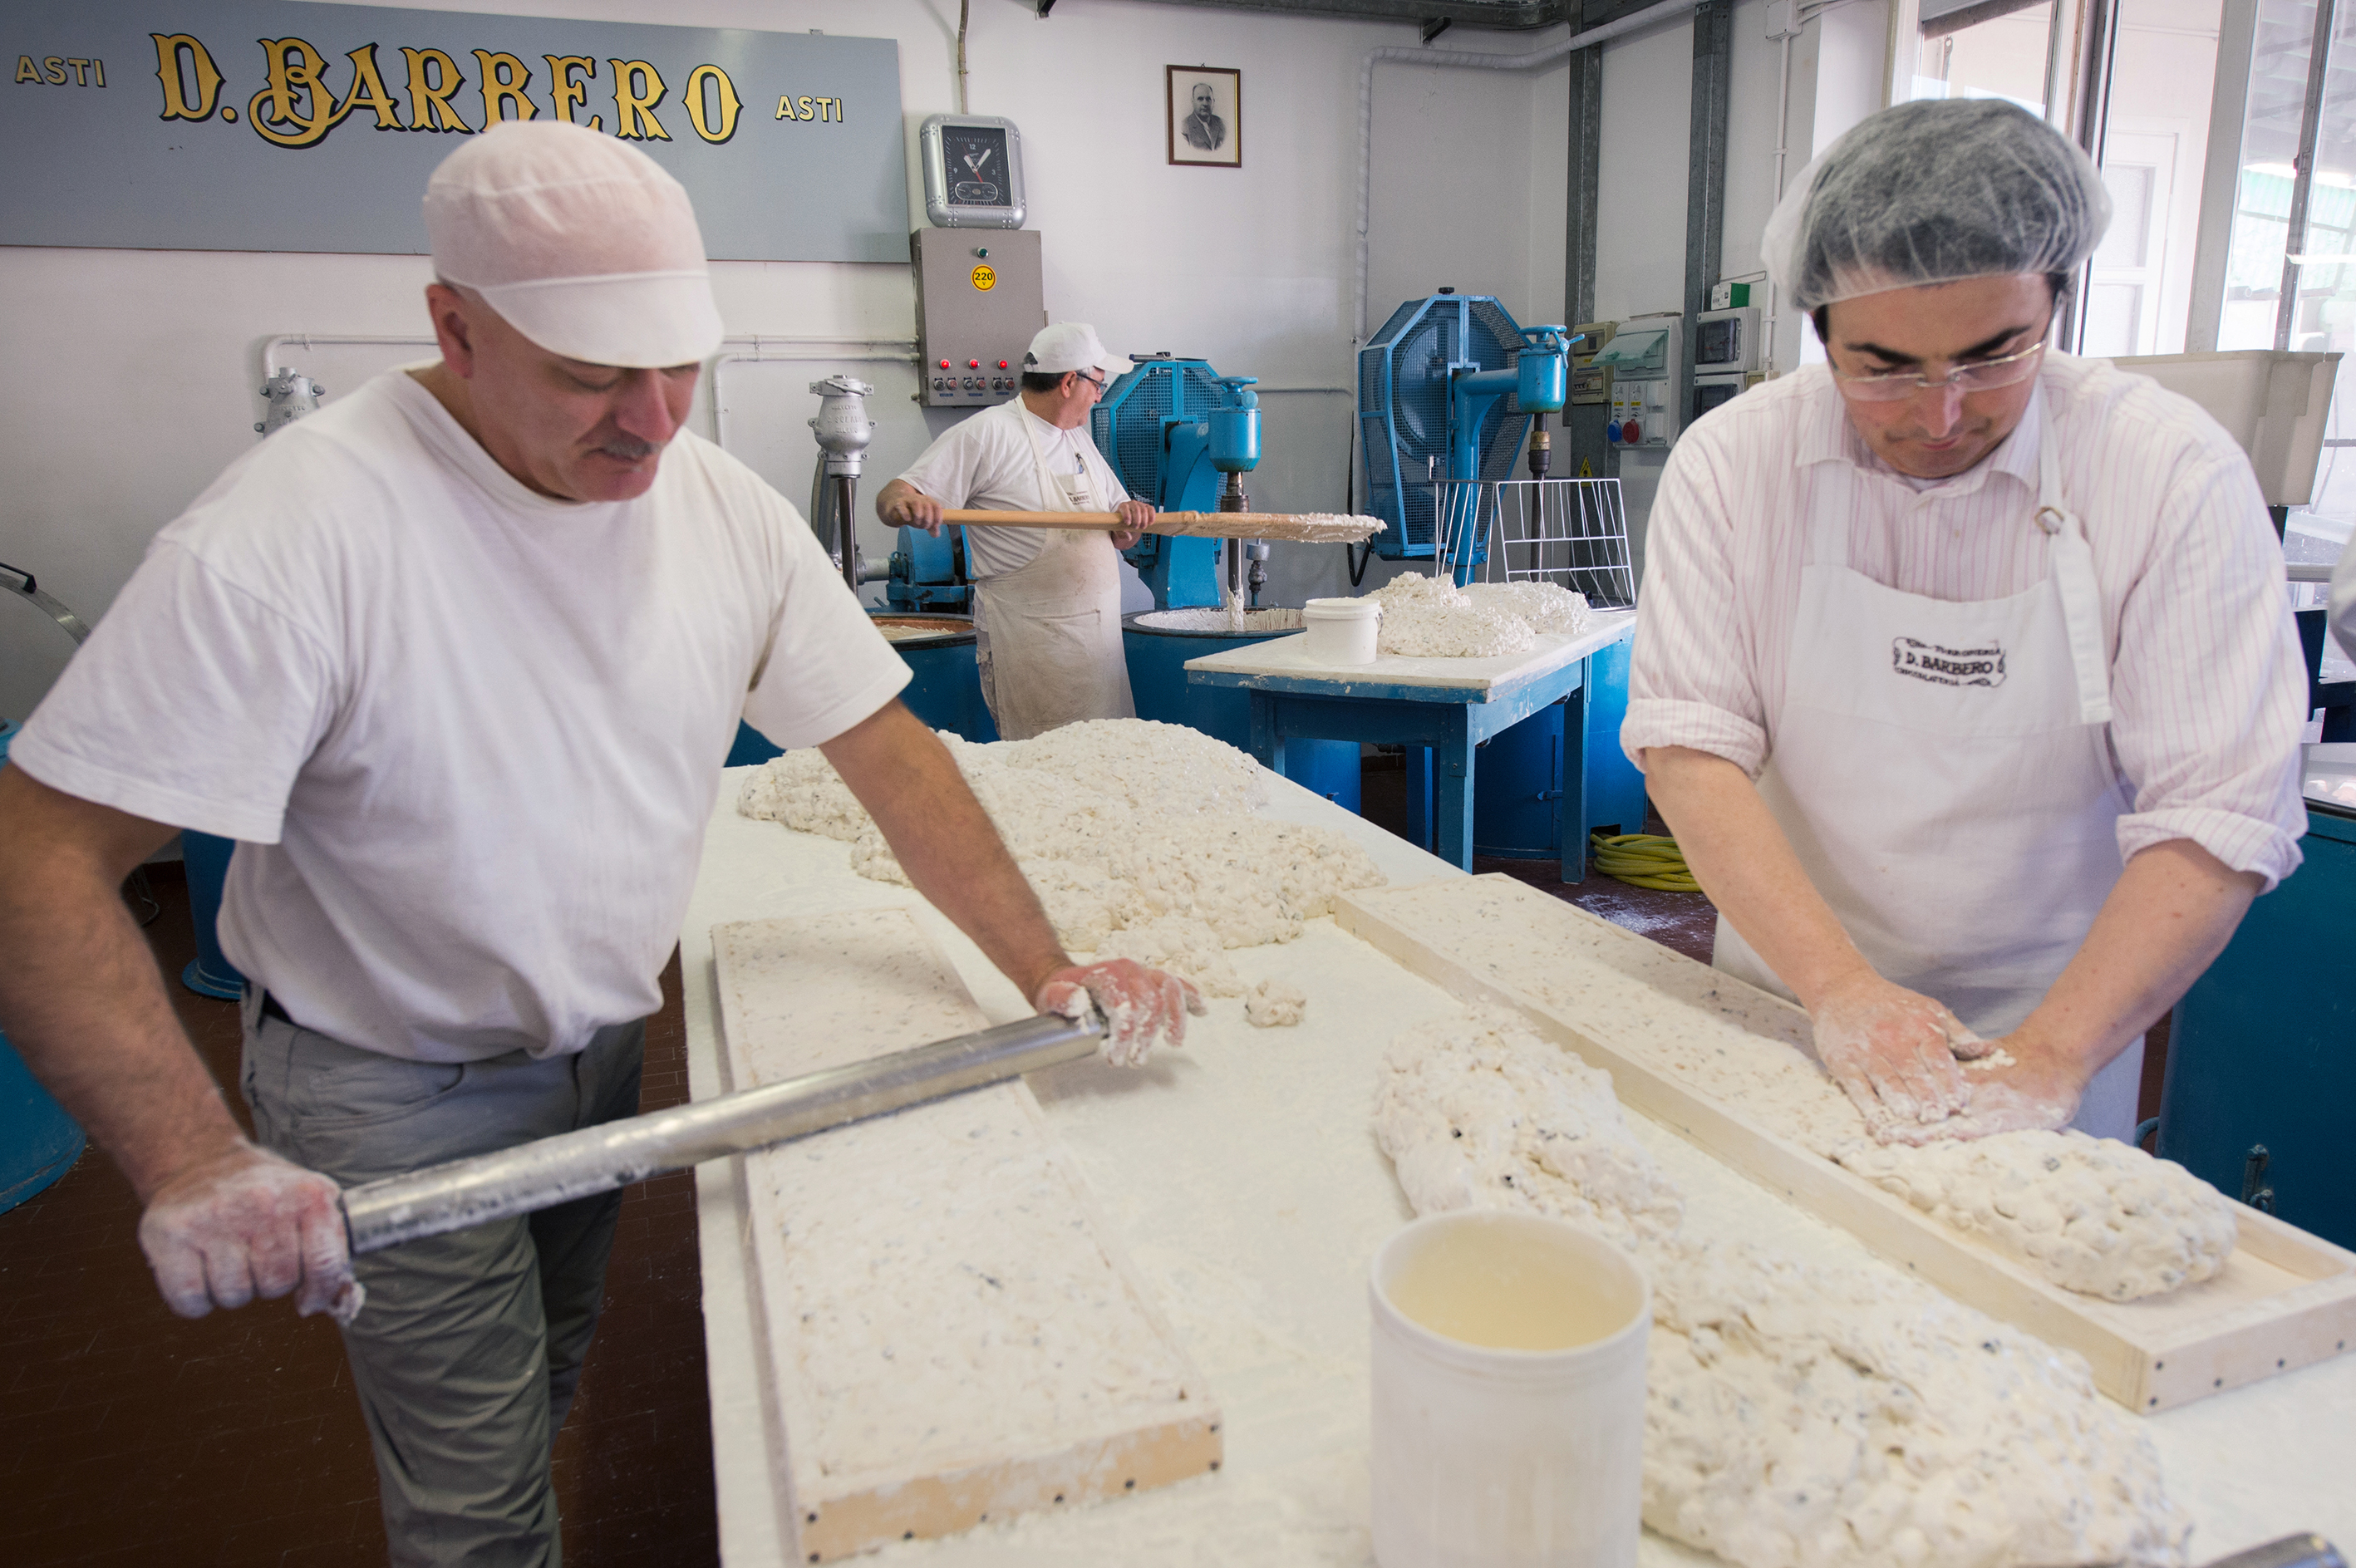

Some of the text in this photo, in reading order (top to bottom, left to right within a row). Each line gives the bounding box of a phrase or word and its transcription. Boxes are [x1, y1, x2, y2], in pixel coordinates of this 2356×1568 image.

[15, 55, 106, 88] ASTI
[248, 37, 744, 149] BARBERO
[775, 94, 844, 124] ASTI
[1922, 656, 1993, 675] BARBERO
